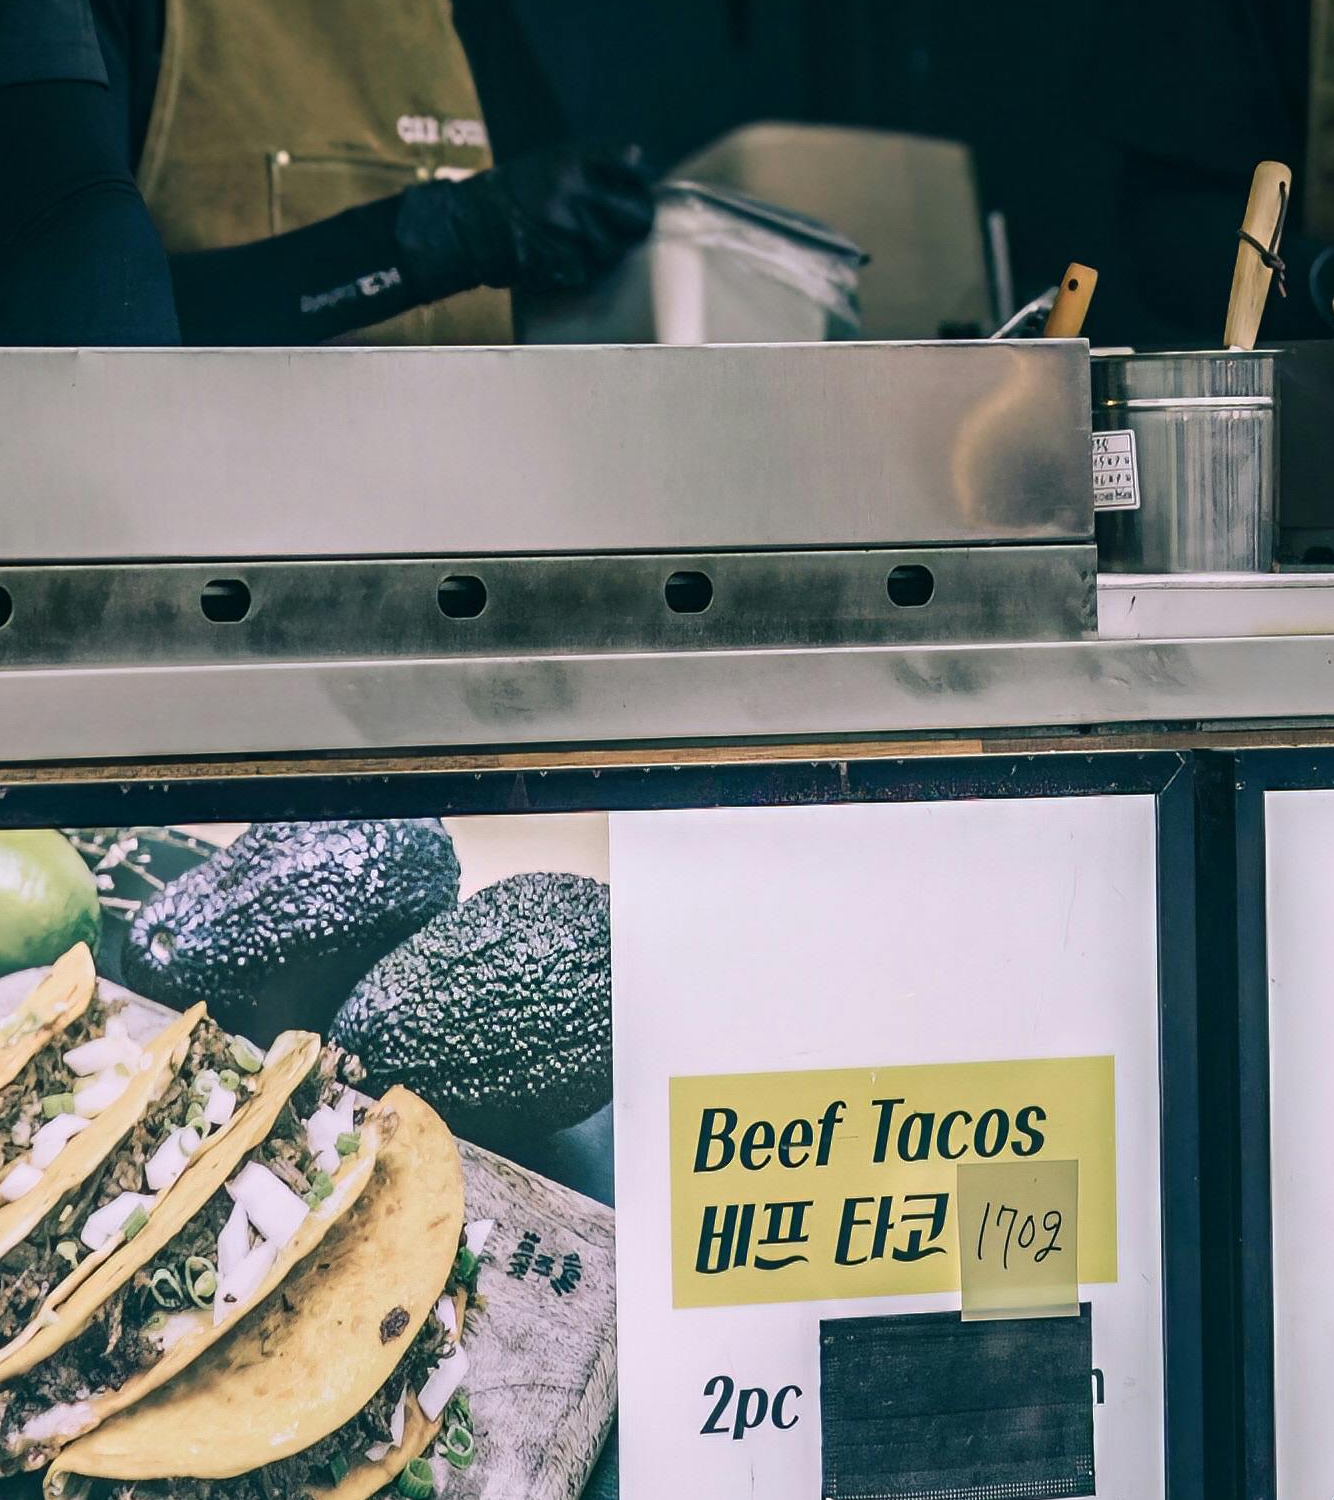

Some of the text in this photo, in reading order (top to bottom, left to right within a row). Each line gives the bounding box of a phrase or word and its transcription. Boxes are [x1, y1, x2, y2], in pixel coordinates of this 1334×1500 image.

[693, 1097, 1048, 1174] Beef Tacos
[694, 1192, 951, 1275] 비프 타코
[699, 1374, 803, 1440] 2pc
